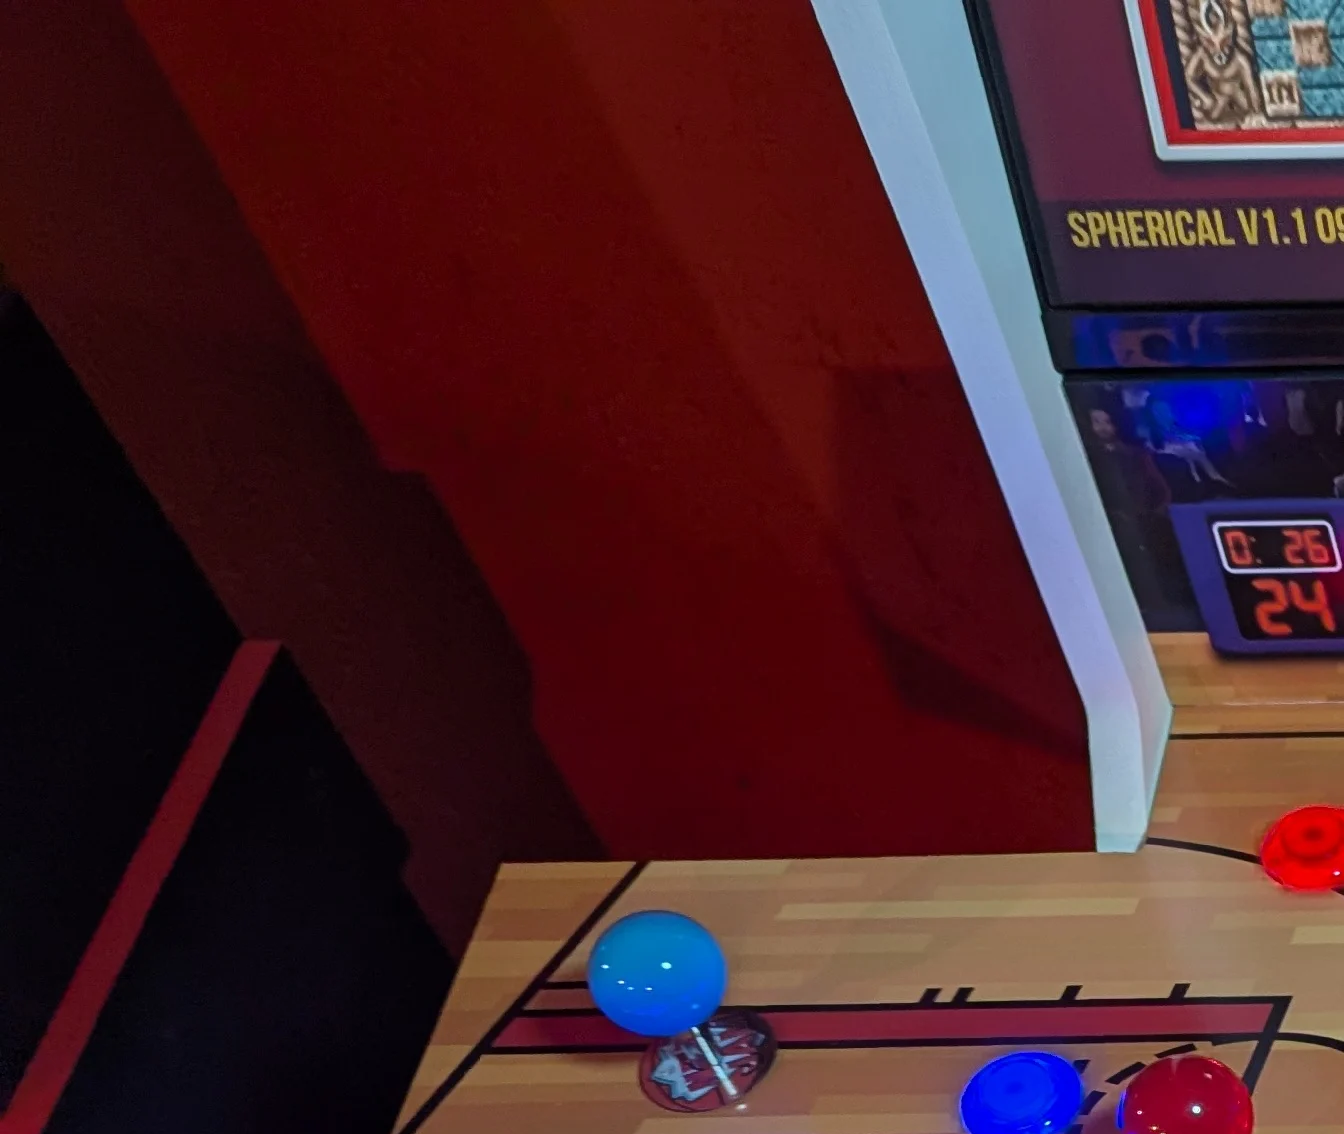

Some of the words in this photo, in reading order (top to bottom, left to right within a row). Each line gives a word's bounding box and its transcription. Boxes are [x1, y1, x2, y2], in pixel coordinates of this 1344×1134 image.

[1066, 208, 1237, 247] SPHERICAL
[1281, 529, 1330, 564] 26
[1251, 578, 1335, 635] 24
